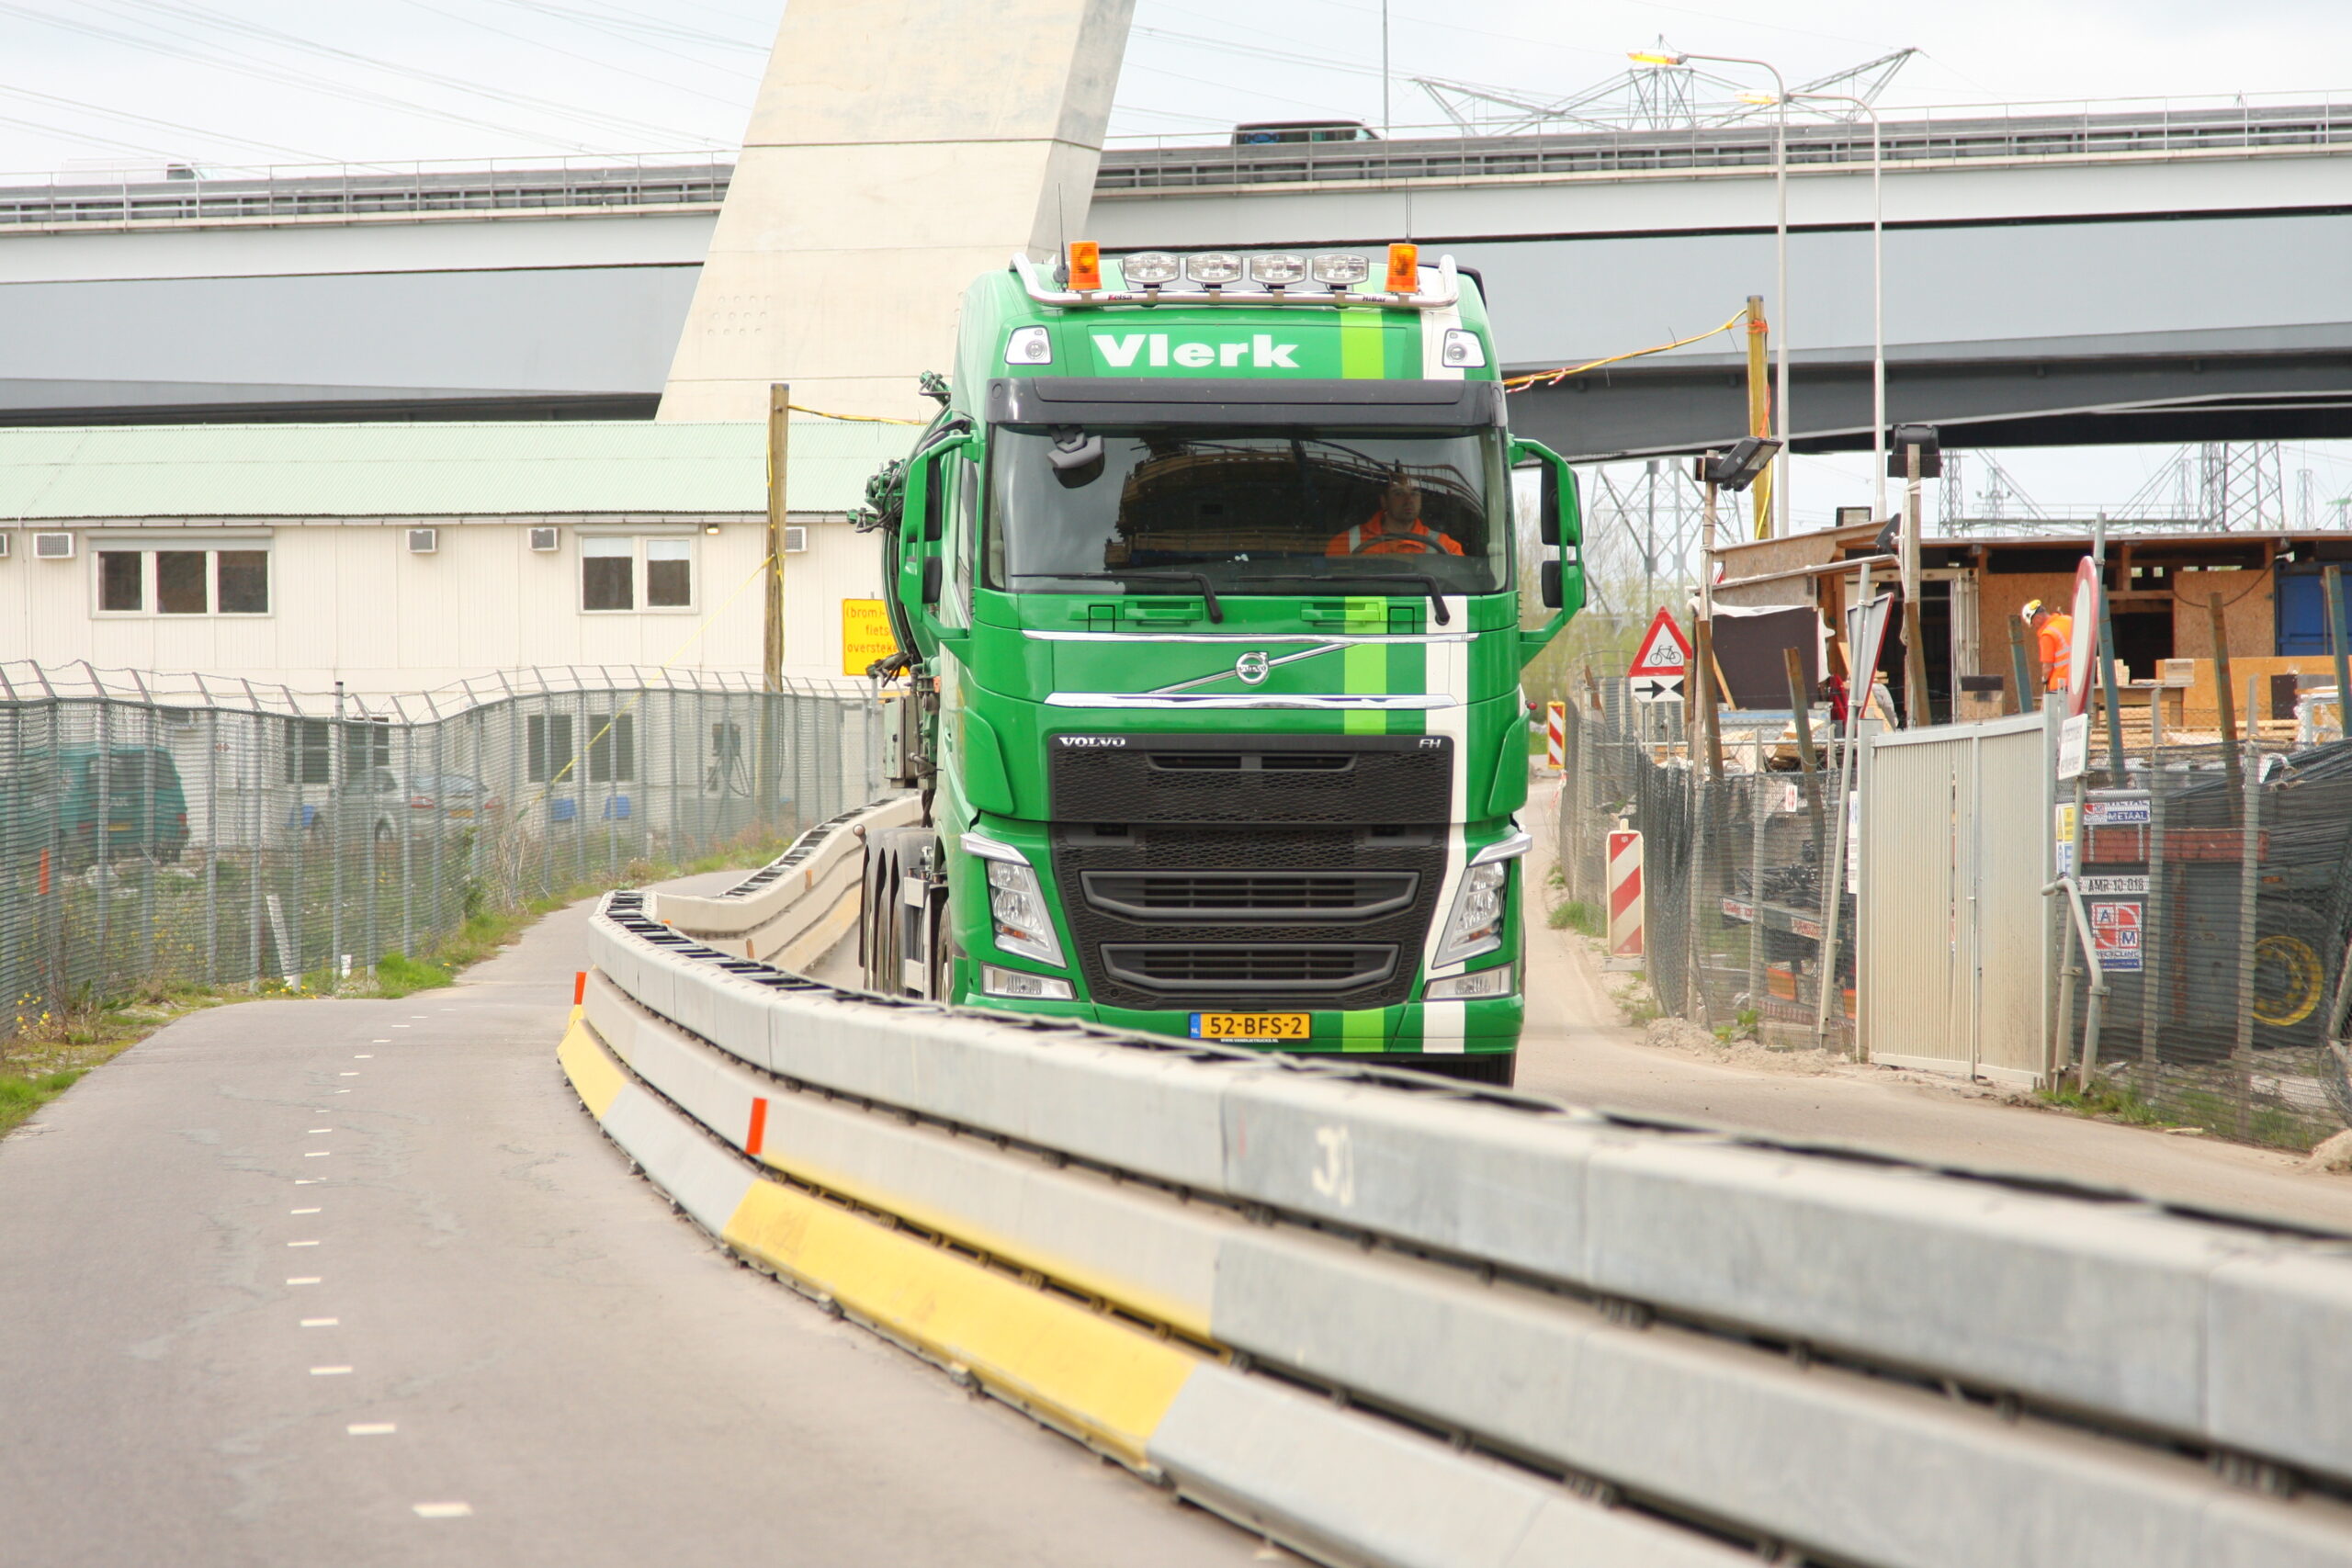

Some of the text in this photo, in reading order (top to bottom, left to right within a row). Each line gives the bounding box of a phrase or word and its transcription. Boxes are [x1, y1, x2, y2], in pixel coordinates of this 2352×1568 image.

[1092, 333, 1300, 367] Vlerk
[846, 606, 886, 618] (brom)-
[865, 624, 890, 636] fiets
[1059, 737, 1125, 747] VOLVO
[1419, 739, 1442, 749] FH
[2108, 811, 2147, 820] METAAL
[2100, 909, 2110, 922] A
[2121, 931, 2136, 944] M
[1210, 1017, 1302, 1034] 52-BFS-2
